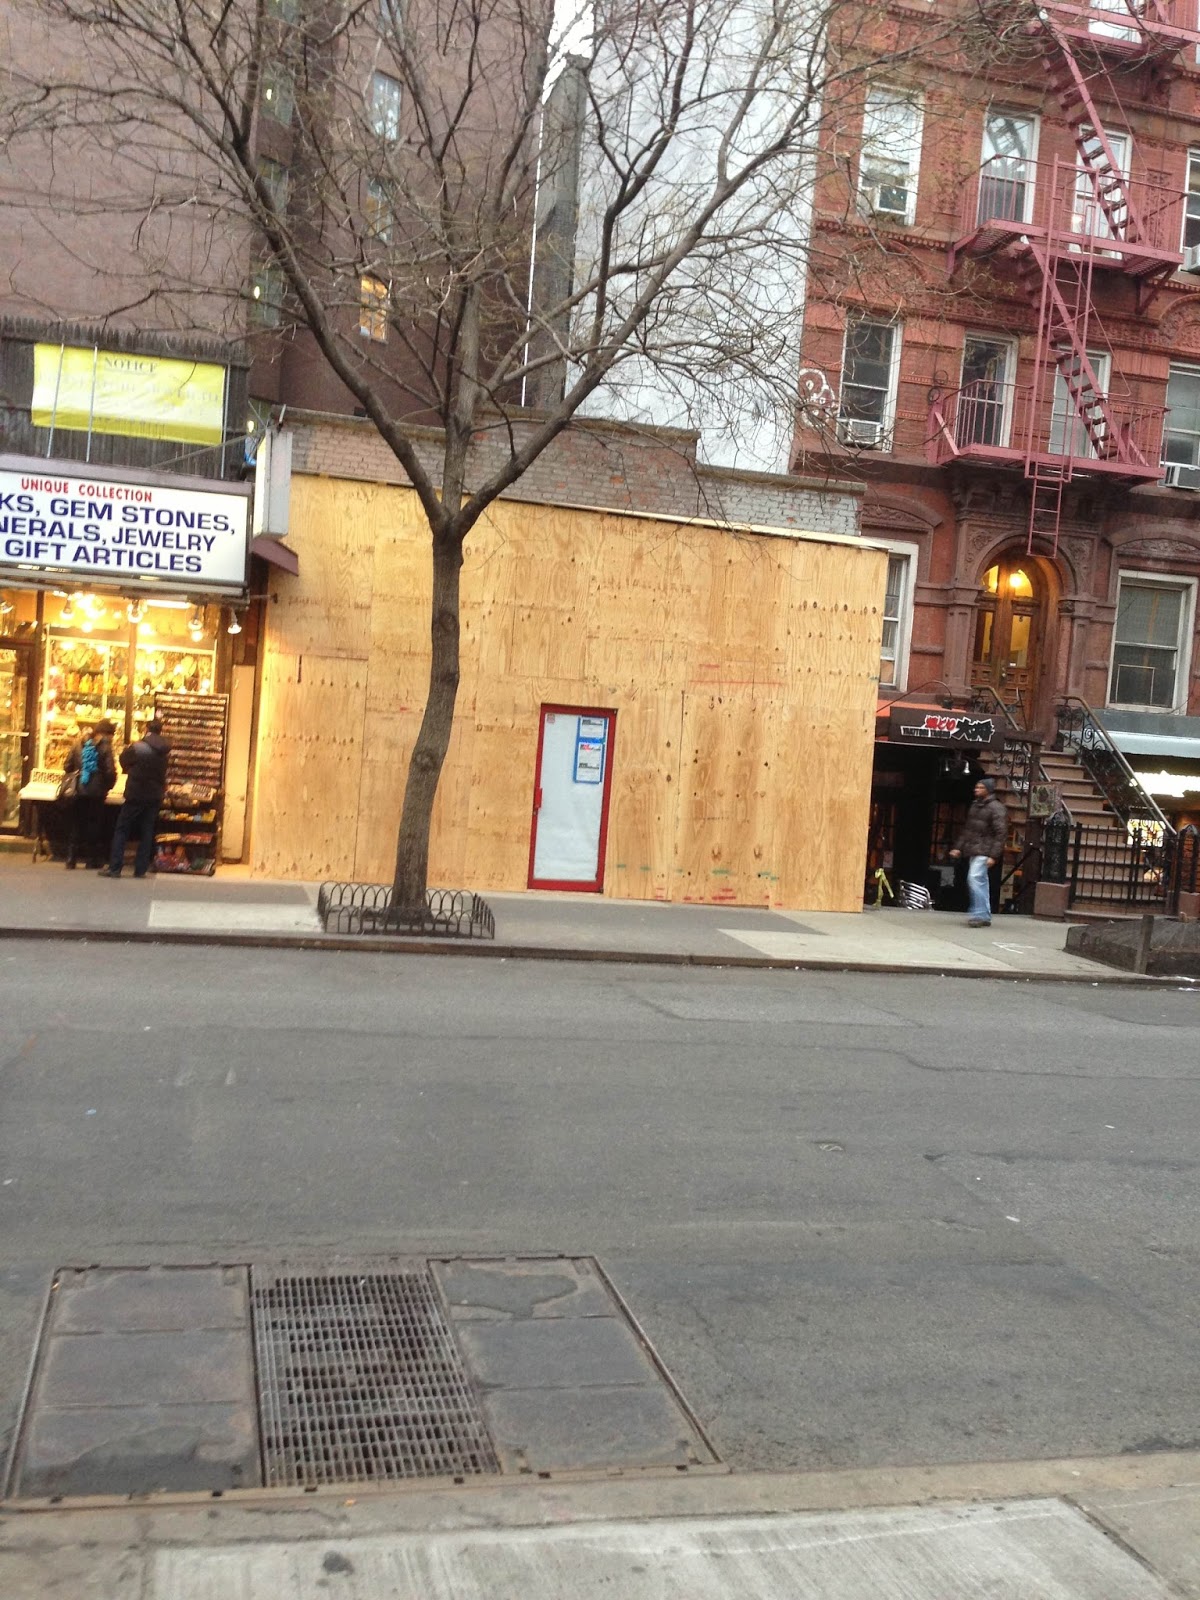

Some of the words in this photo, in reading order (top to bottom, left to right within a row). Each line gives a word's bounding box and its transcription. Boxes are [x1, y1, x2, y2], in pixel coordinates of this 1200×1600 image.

[105, 356, 157, 374] NOTICE
[21, 478, 69, 494] UNIQUE
[79, 483, 153, 502] COLLECTION
[0, 492, 40, 517] KS,
[50, 497, 113, 521] GEM
[122, 504, 235, 535] STONES,
[112, 526, 216, 552] JEWELRY
[5, 538, 67, 561] GIFT
[72, 544, 202, 573] ARTICLES
